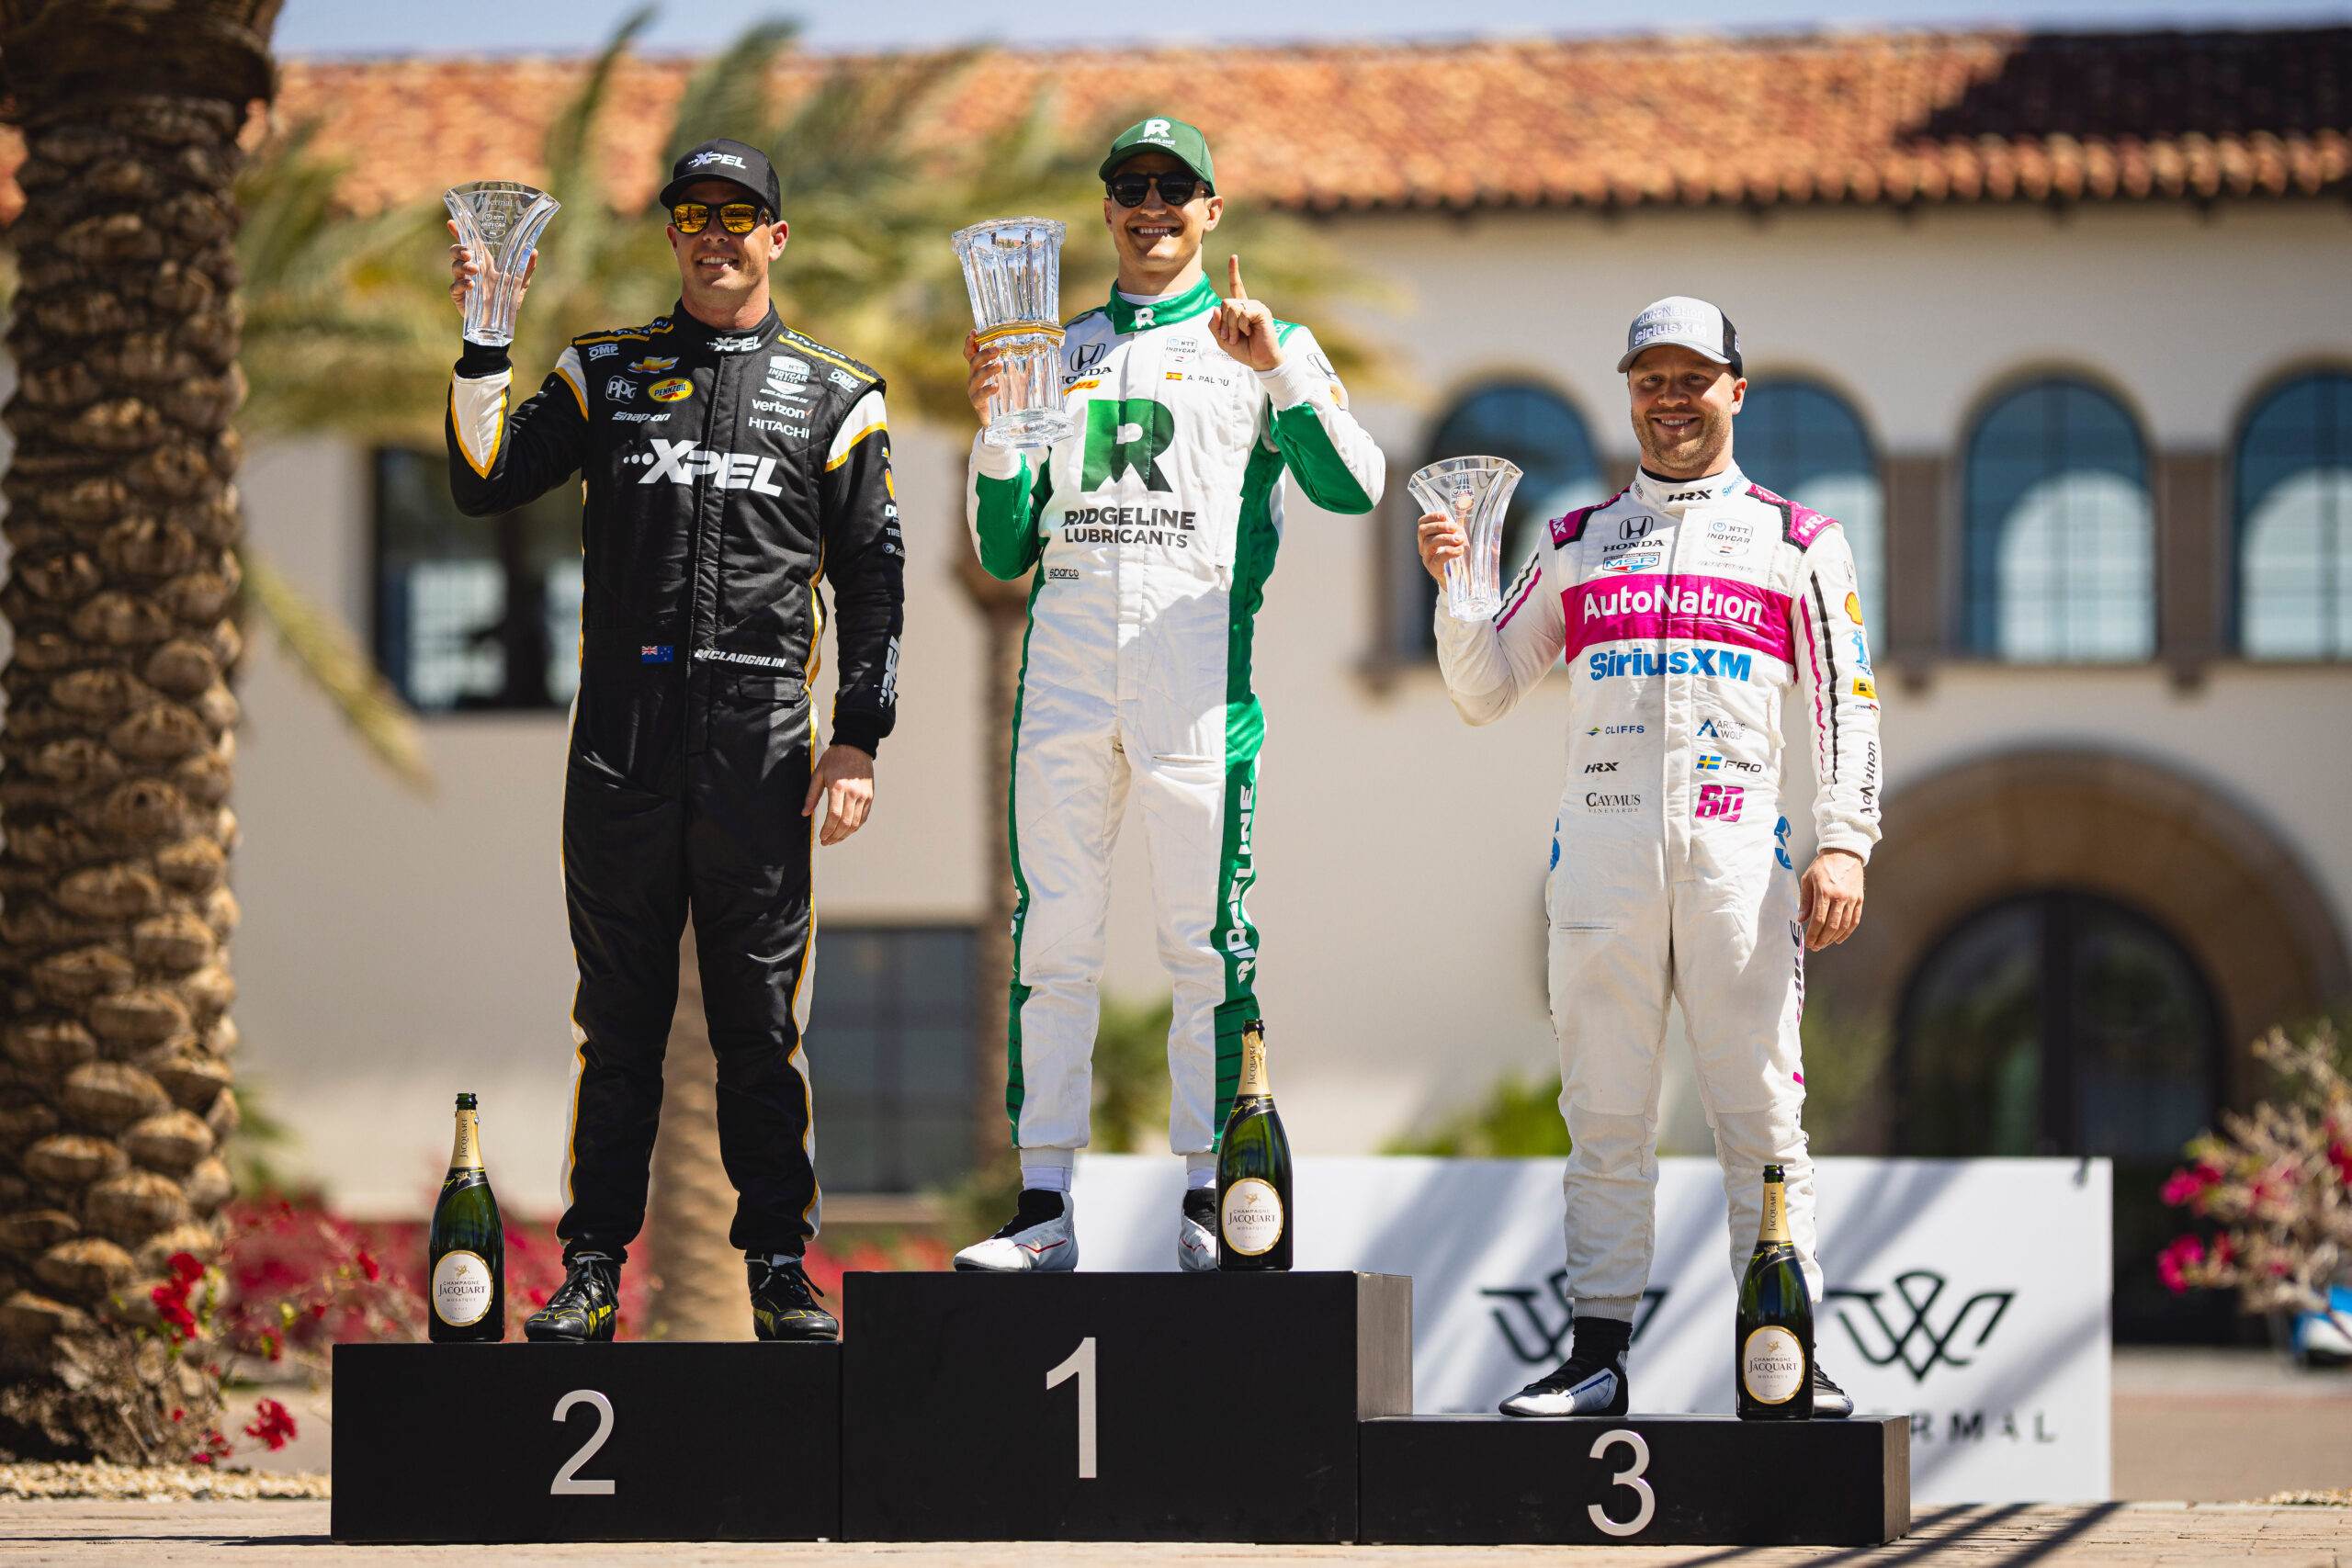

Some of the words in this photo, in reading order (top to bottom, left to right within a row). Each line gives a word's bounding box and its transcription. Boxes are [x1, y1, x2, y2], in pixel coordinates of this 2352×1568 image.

[1143, 118, 1171, 138] R
[692, 151, 747, 170] XPEL
[1134, 307, 1157, 329] R
[1637, 304, 1706, 326] AutoNation
[1634, 321, 1708, 345] SiriusXM
[588, 345, 619, 359] OMP
[713, 336, 763, 352] XPEL
[1165, 345, 1197, 355] INDYCAR
[767, 367, 808, 383] INDYCAR
[829, 371, 859, 390] OMP
[653, 383, 688, 397] PENNZOIL
[611, 411, 672, 423] Snap-on
[752, 399, 807, 420] verizon
[748, 416, 810, 439] HITACHI
[1080, 398, 1175, 493] R
[638, 438, 783, 498] XPEL
[1667, 489, 1713, 502] HRX
[1060, 506, 1197, 532] RIDGELINE
[1728, 525, 1749, 534] NTT
[1064, 527, 1188, 549] LUBRICANTS
[1602, 539, 1665, 553] HONDA
[1706, 532, 1751, 544] INDYCAR
[1605, 557, 1657, 569] MSR
[1048, 567, 1080, 580] sparco
[1583, 584, 1763, 626] AutoNation
[694, 649, 787, 669] MCLAUGHLIN
[1589, 647, 1752, 682] SiriusXM
[1605, 725, 1645, 735] CLIFFS
[1716, 719, 1747, 731] ARCTIC
[1720, 729, 1744, 740] WOLF
[1584, 761, 1620, 774] HRX
[1586, 792, 1642, 807] CAYMUS
[1227, 1212, 1276, 1226] JACQUART
[437, 1283, 487, 1298] JACQUART
[1747, 1359, 1799, 1374] JACQUART
[1046, 1336, 1098, 1479] 1
[549, 1389, 616, 1495] 2
[1587, 1428, 1657, 1538] 3
